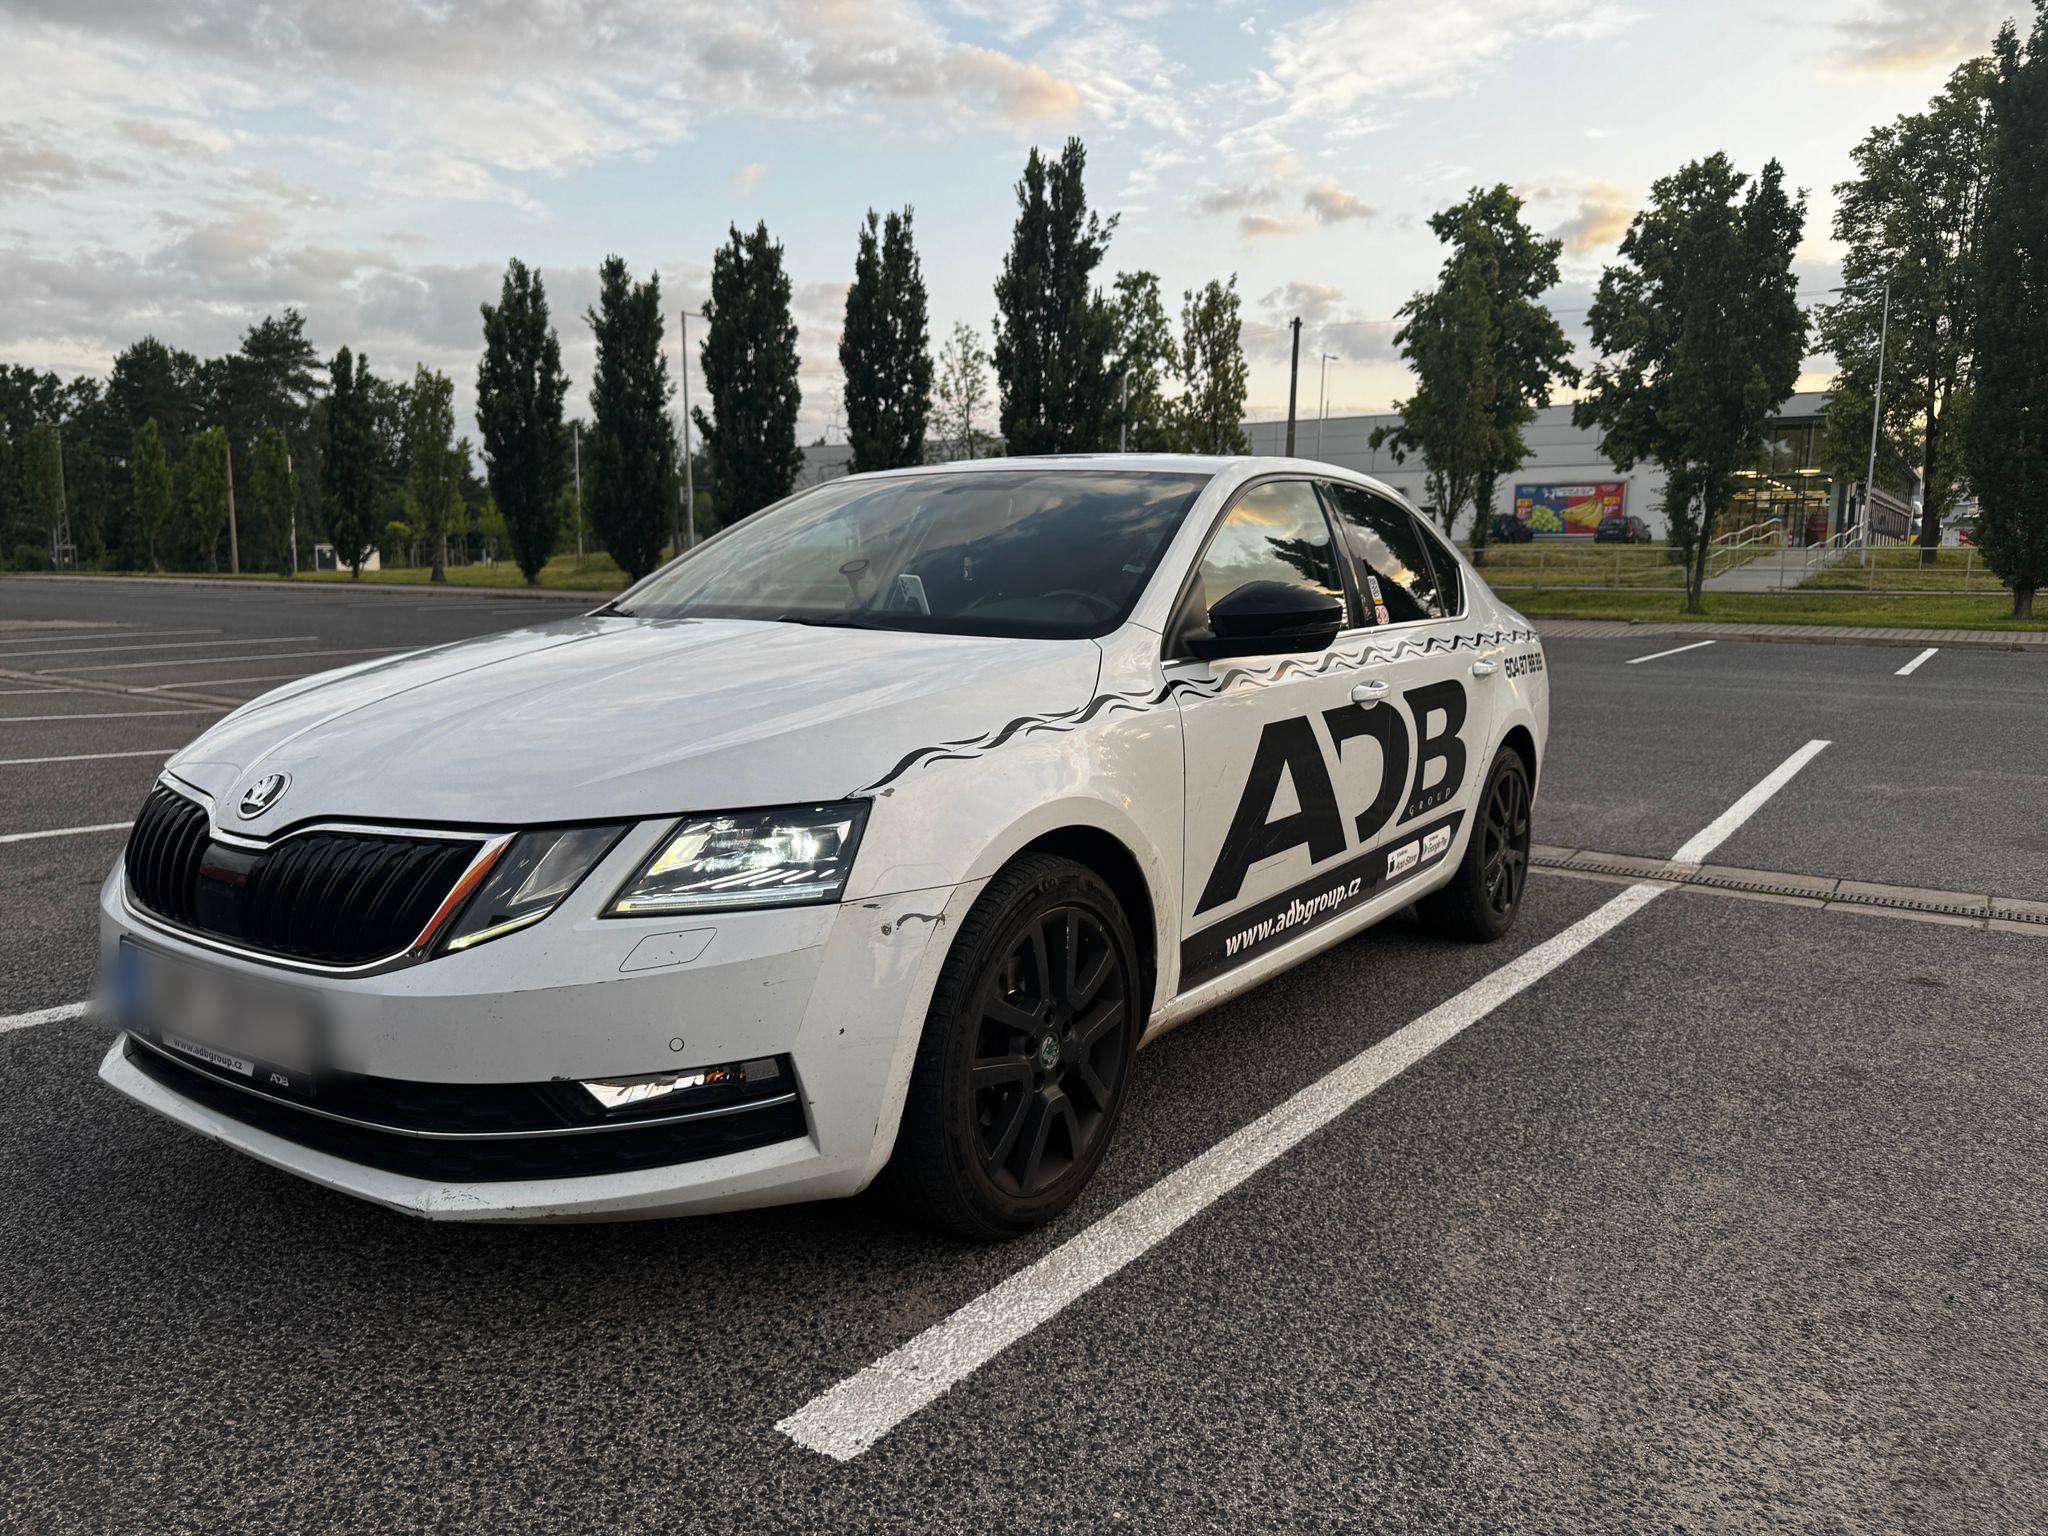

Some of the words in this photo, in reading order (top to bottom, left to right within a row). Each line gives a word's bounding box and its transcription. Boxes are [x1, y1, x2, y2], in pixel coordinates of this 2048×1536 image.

[1193, 679, 1467, 917] ADB
[1409, 787, 1451, 817] GROUP
[1225, 877, 1361, 957] www.adbgroup.cz
[173, 1039, 243, 1070] www.adbgroup.cz
[270, 1072, 289, 1087] ADB
